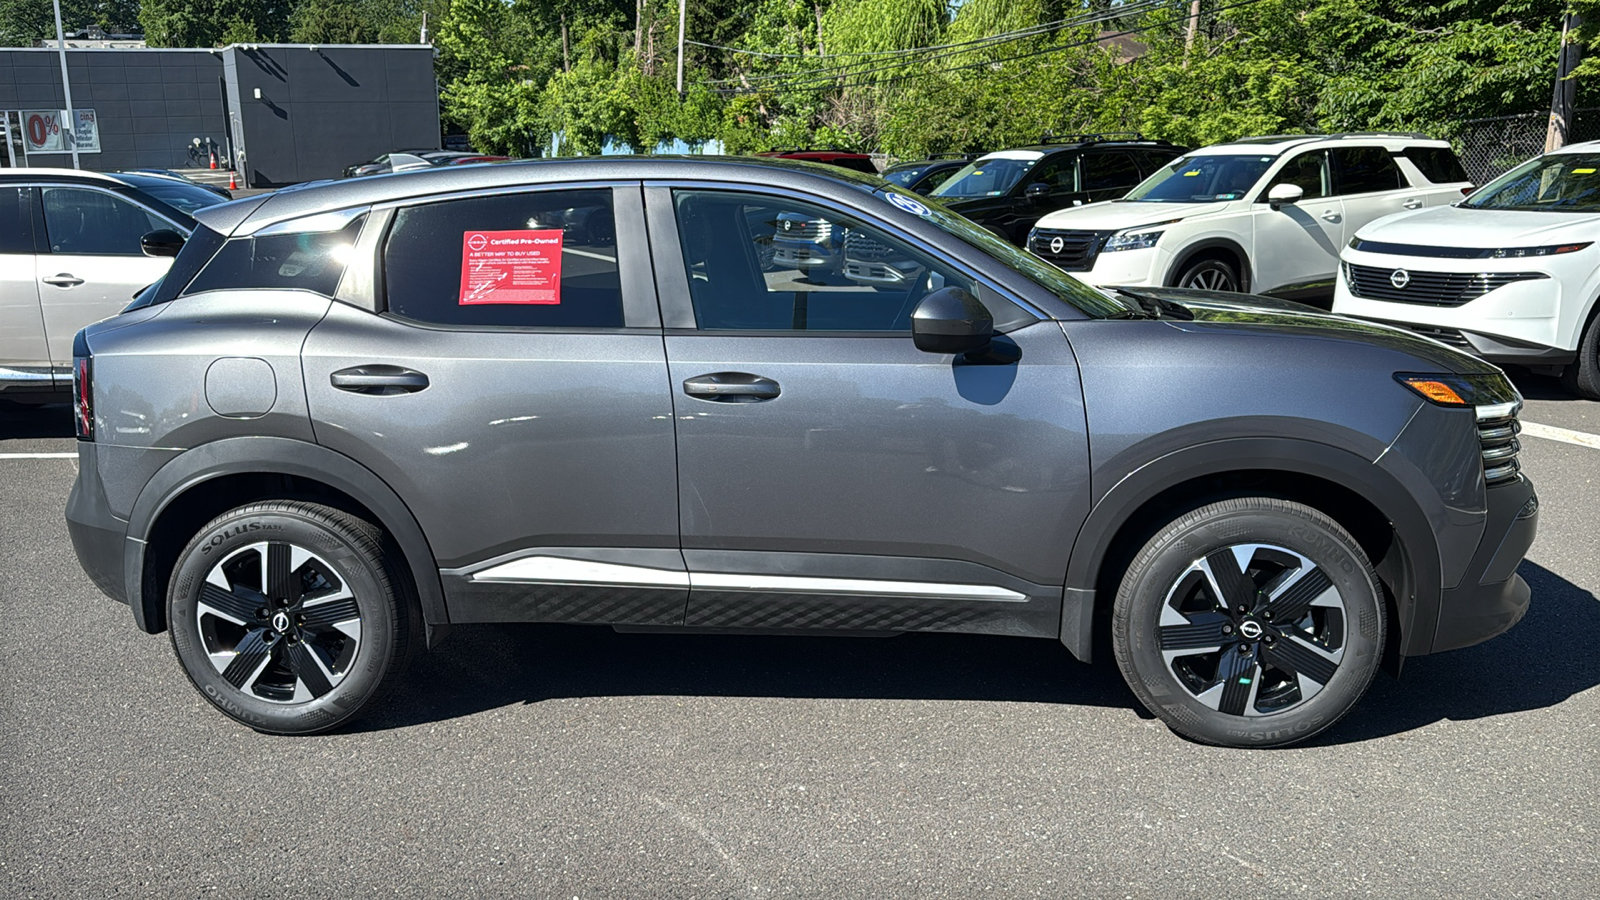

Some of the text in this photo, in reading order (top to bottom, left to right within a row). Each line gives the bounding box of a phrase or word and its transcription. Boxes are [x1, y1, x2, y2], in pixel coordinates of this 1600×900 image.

[28, 114, 59, 147] 0%
[202, 521, 262, 555] SOLUS
[1250, 714, 1324, 741] SOLUS
